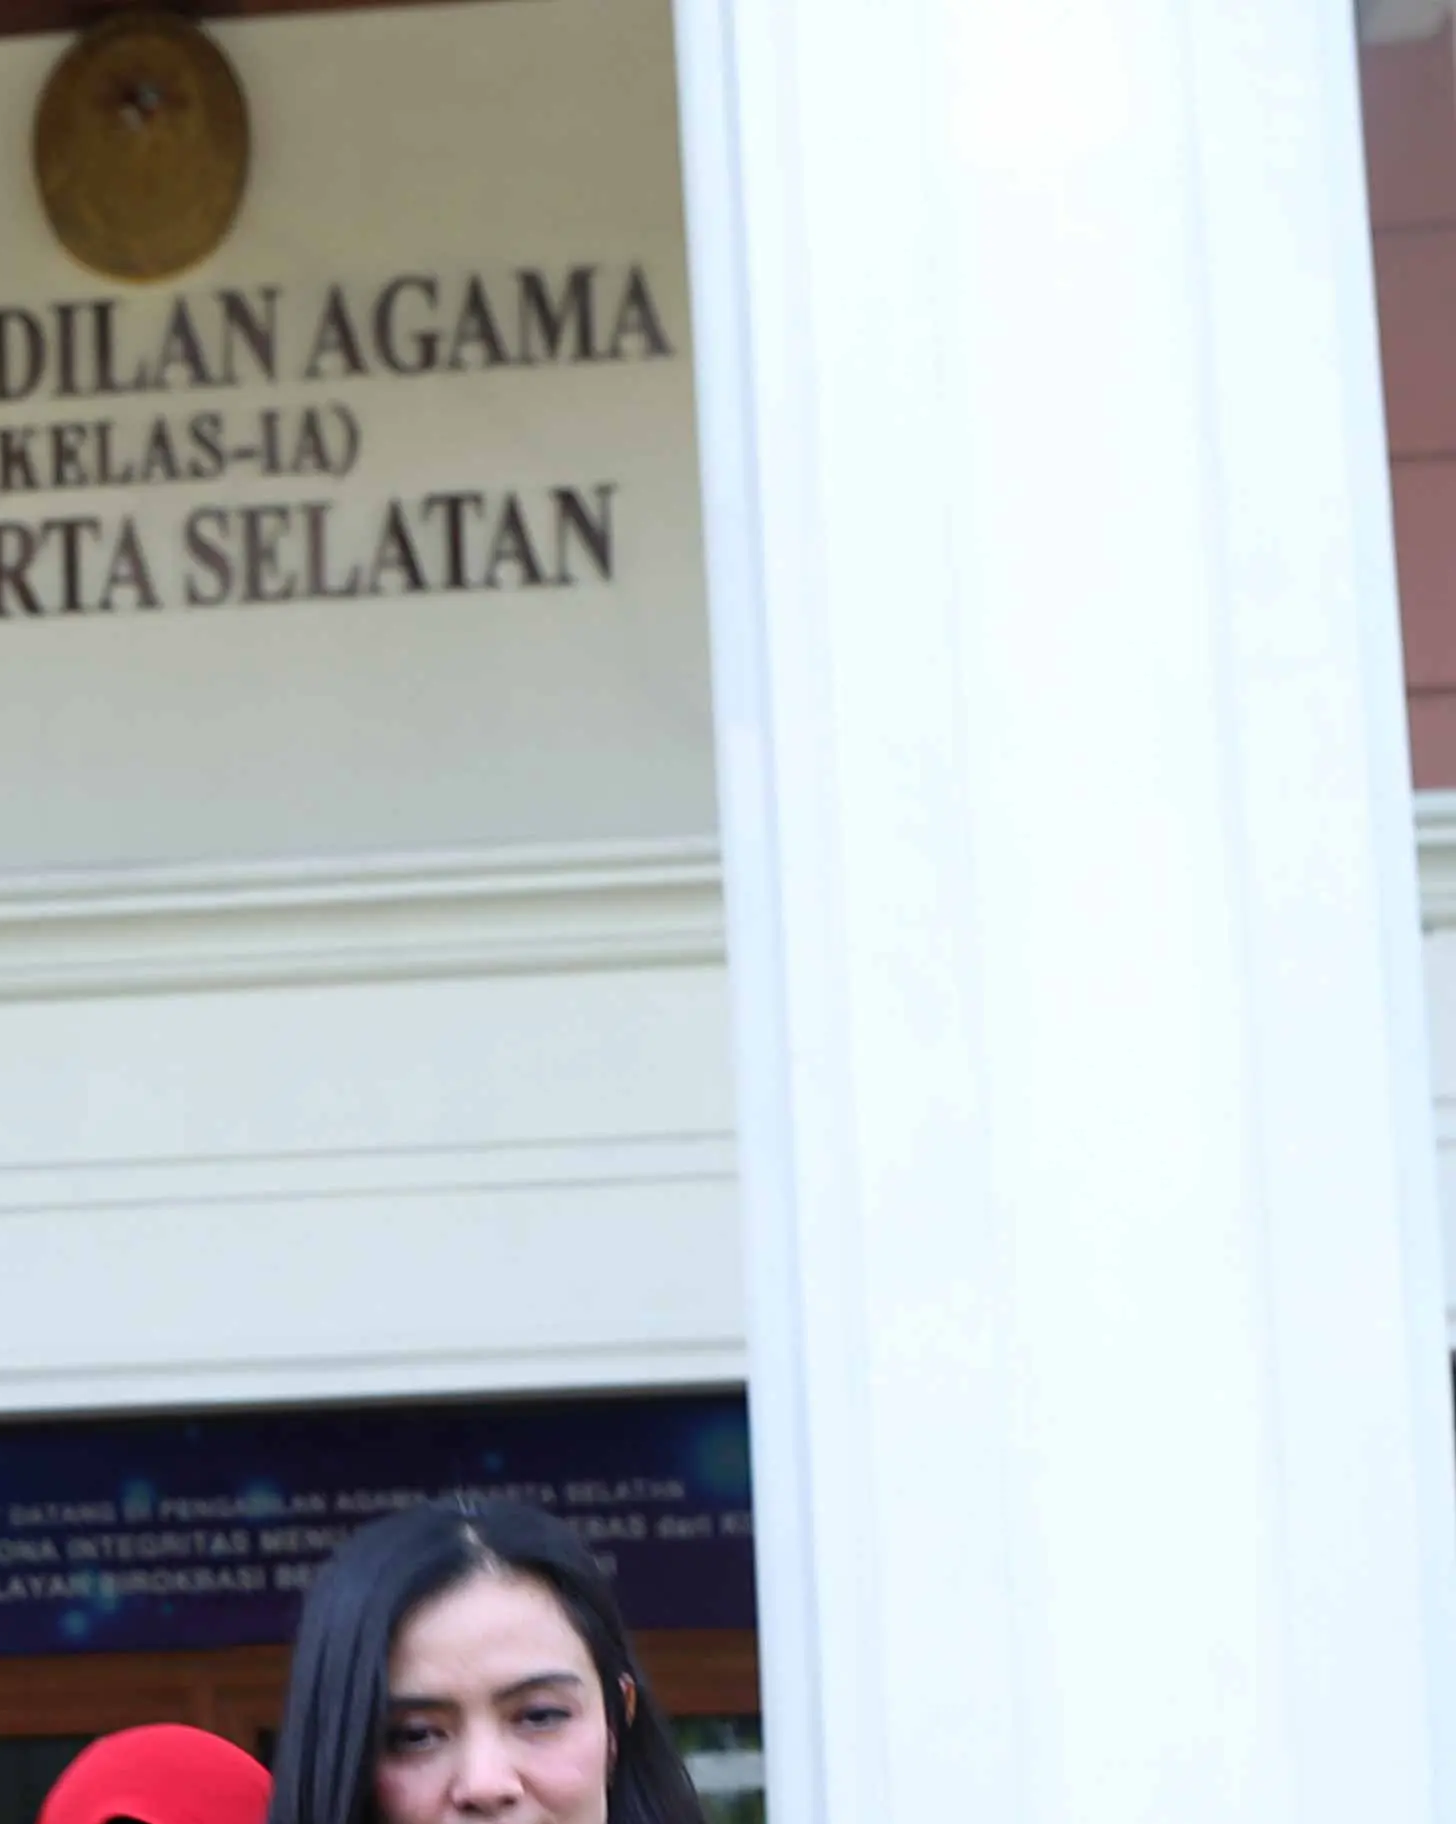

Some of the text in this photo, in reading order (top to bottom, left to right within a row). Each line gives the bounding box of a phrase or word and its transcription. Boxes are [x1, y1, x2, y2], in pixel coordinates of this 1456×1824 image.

[306, 263, 672, 380] AGAMA
[182, 485, 619, 609] SELATAN
[65, 1528, 250, 1562] INTEGRITAS
